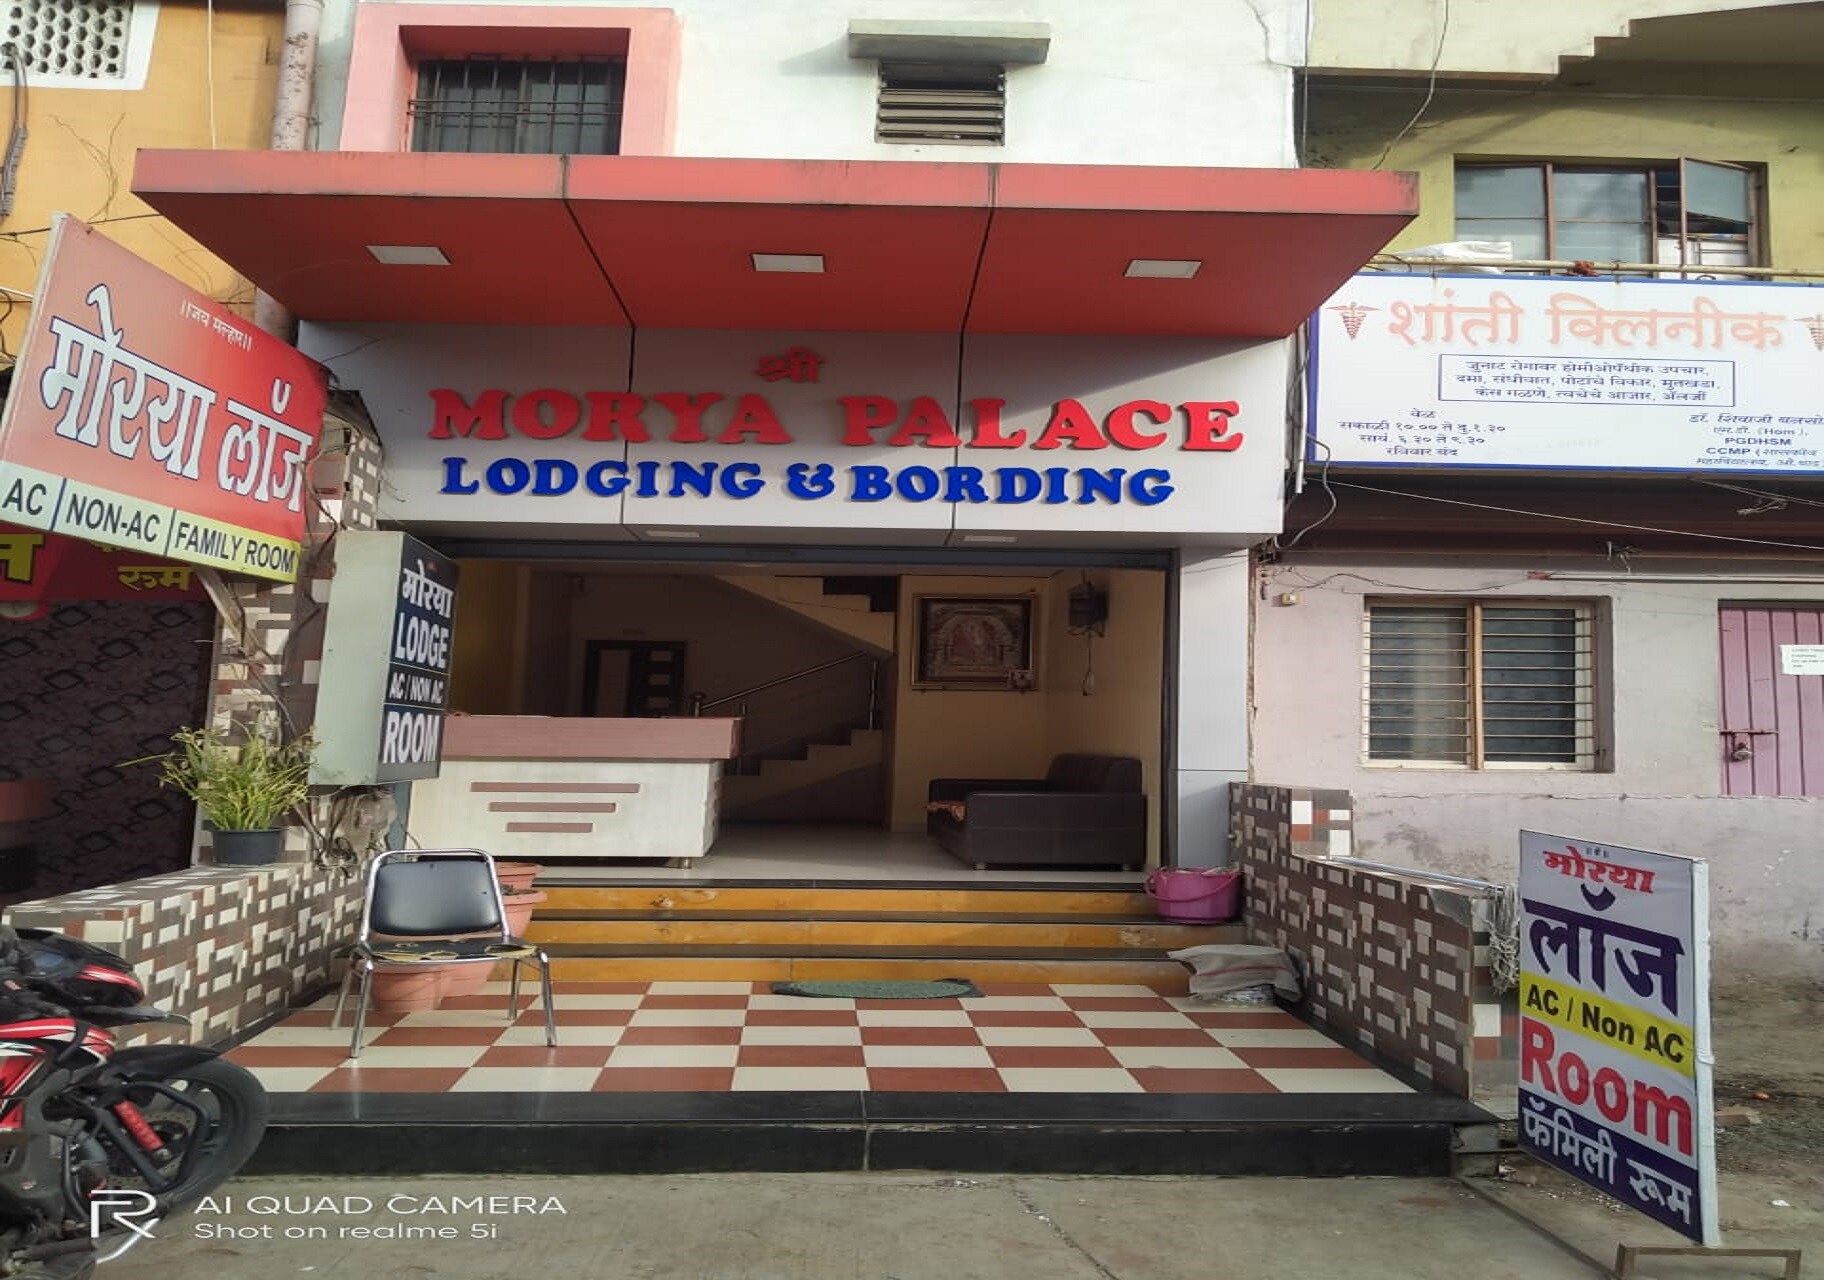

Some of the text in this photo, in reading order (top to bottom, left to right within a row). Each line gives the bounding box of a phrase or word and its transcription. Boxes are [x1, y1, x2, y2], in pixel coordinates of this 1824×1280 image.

[1387, 288, 1787, 349] शांती क्लिनीक
[755, 346, 823, 383] श्री
[40, 284, 312, 513] मोरया लॉज
[428, 387, 1245, 451] MORYA PALACE
[1706, 447, 1750, 455] CCMP
[1725, 437, 1792, 446] PGDHSM
[440, 456, 1175, 506] LODGING & BORDING
[2, 478, 295, 574] AC NON-AC FAMILY ROOM
[402, 559, 454, 618] मोरया
[394, 612, 449, 669] LODGE
[389, 672, 405, 699] AC
[382, 711, 439, 764] ROOM
[1543, 845, 1655, 893] मोरया
[1522, 883, 1685, 1017] लॉज
[1526, 984, 1559, 1016] AC
[1582, 1002, 1634, 1045] Non
[1644, 1026, 1684, 1063] AC
[1522, 1016, 1693, 1157] Room
